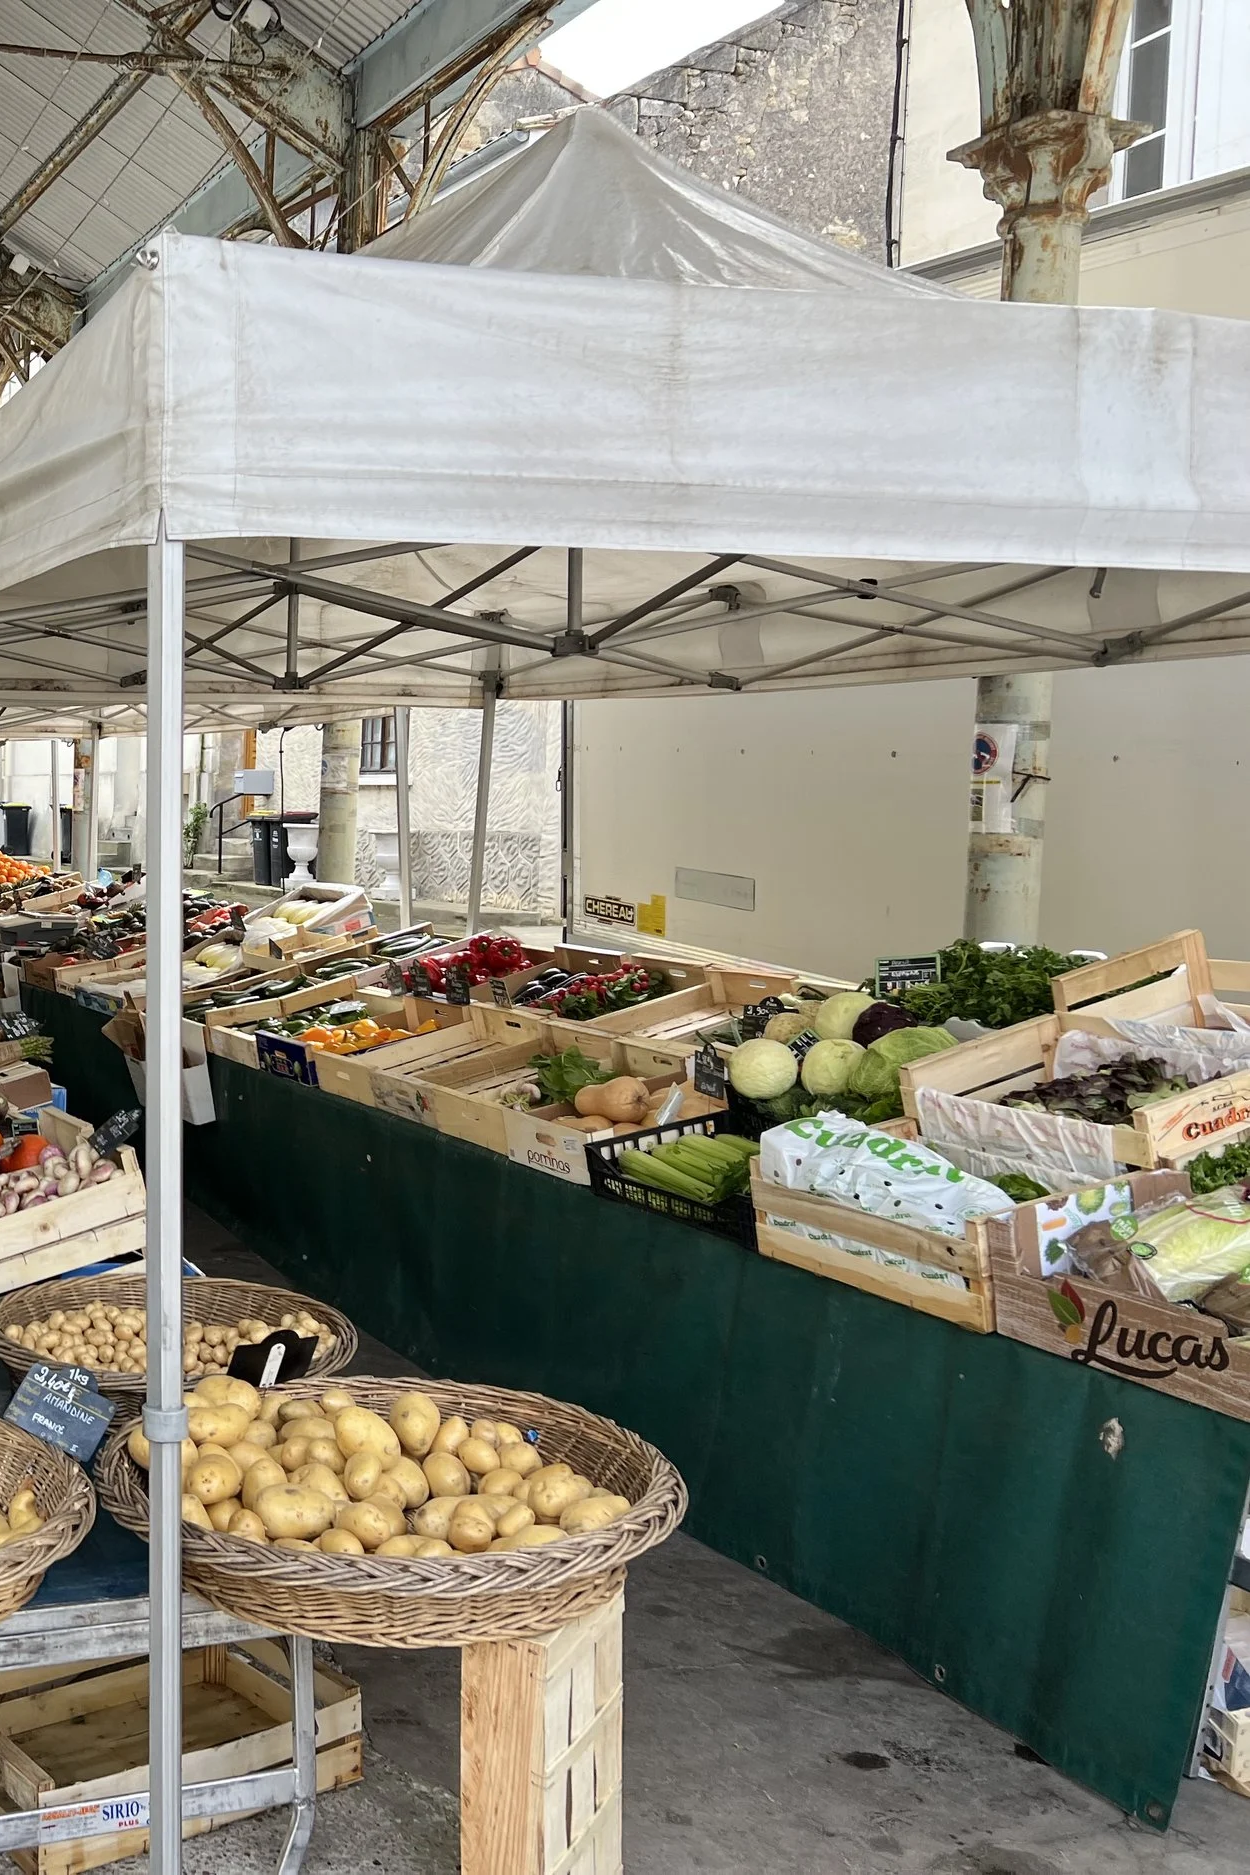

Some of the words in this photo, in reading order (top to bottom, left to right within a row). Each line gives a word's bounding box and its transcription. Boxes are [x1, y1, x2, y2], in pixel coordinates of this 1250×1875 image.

[586, 899, 634, 921] CHEREAU
[1071, 1300, 1230, 1379] Lucas
[31, 1411, 66, 1435] FRANCE
[102, 1800, 140, 1821] SIRIO
[118, 1818, 140, 1828] PLUS
